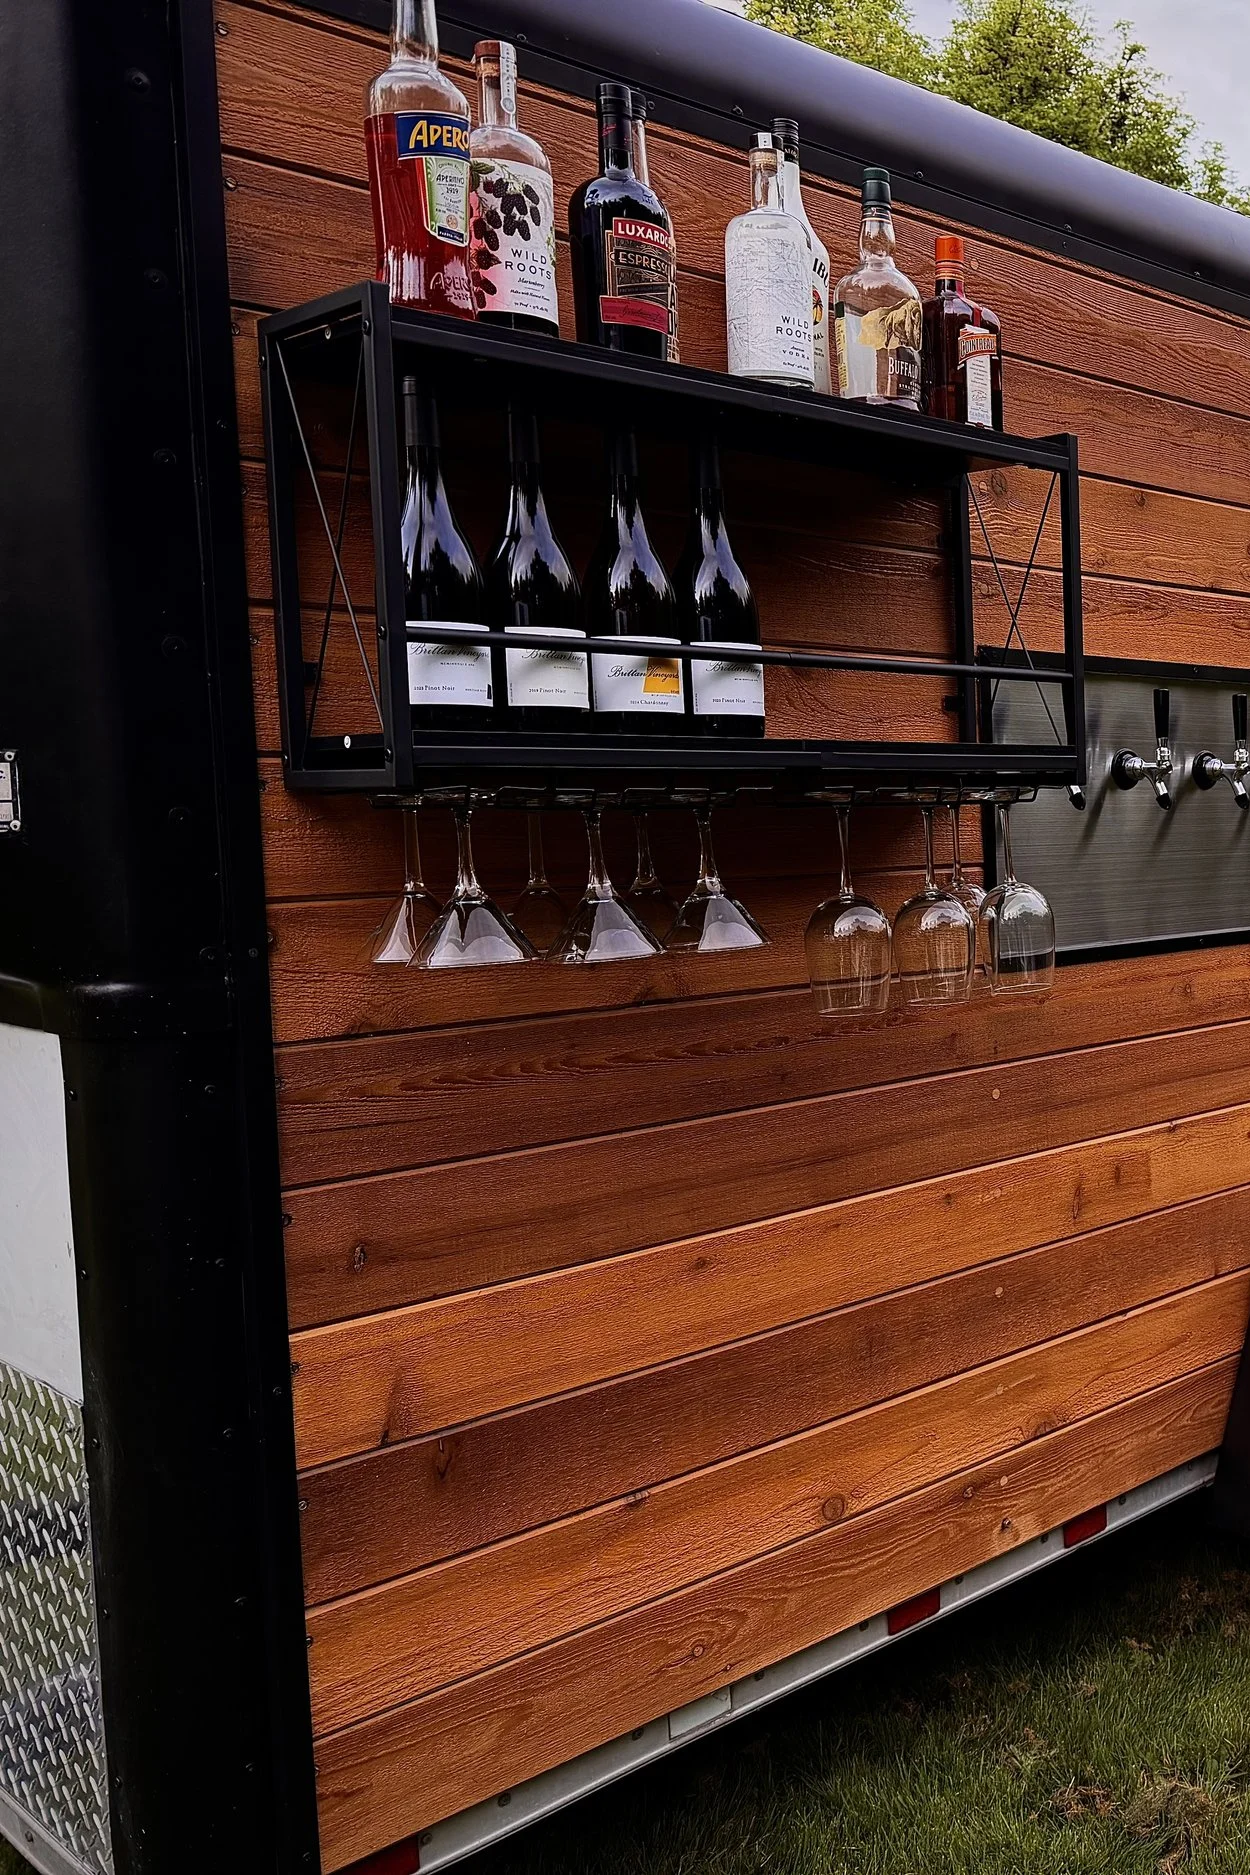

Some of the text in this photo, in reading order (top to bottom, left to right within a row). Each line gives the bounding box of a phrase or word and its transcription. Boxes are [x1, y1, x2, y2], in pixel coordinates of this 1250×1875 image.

[436, 173, 465, 185] APERITIVO
[446, 187, 459, 195] 1919
[511, 247, 547, 265] WILD
[504, 260, 552, 280] ROOTS
[781, 315, 809, 330] WILD
[775, 325, 812, 343] ROOTS
[782, 349, 810, 361] VODKA
[960, 337, 995, 359] COINTREAU
[888, 356, 919, 380] BUFFALO
[607, 664, 646, 678] Brittan
